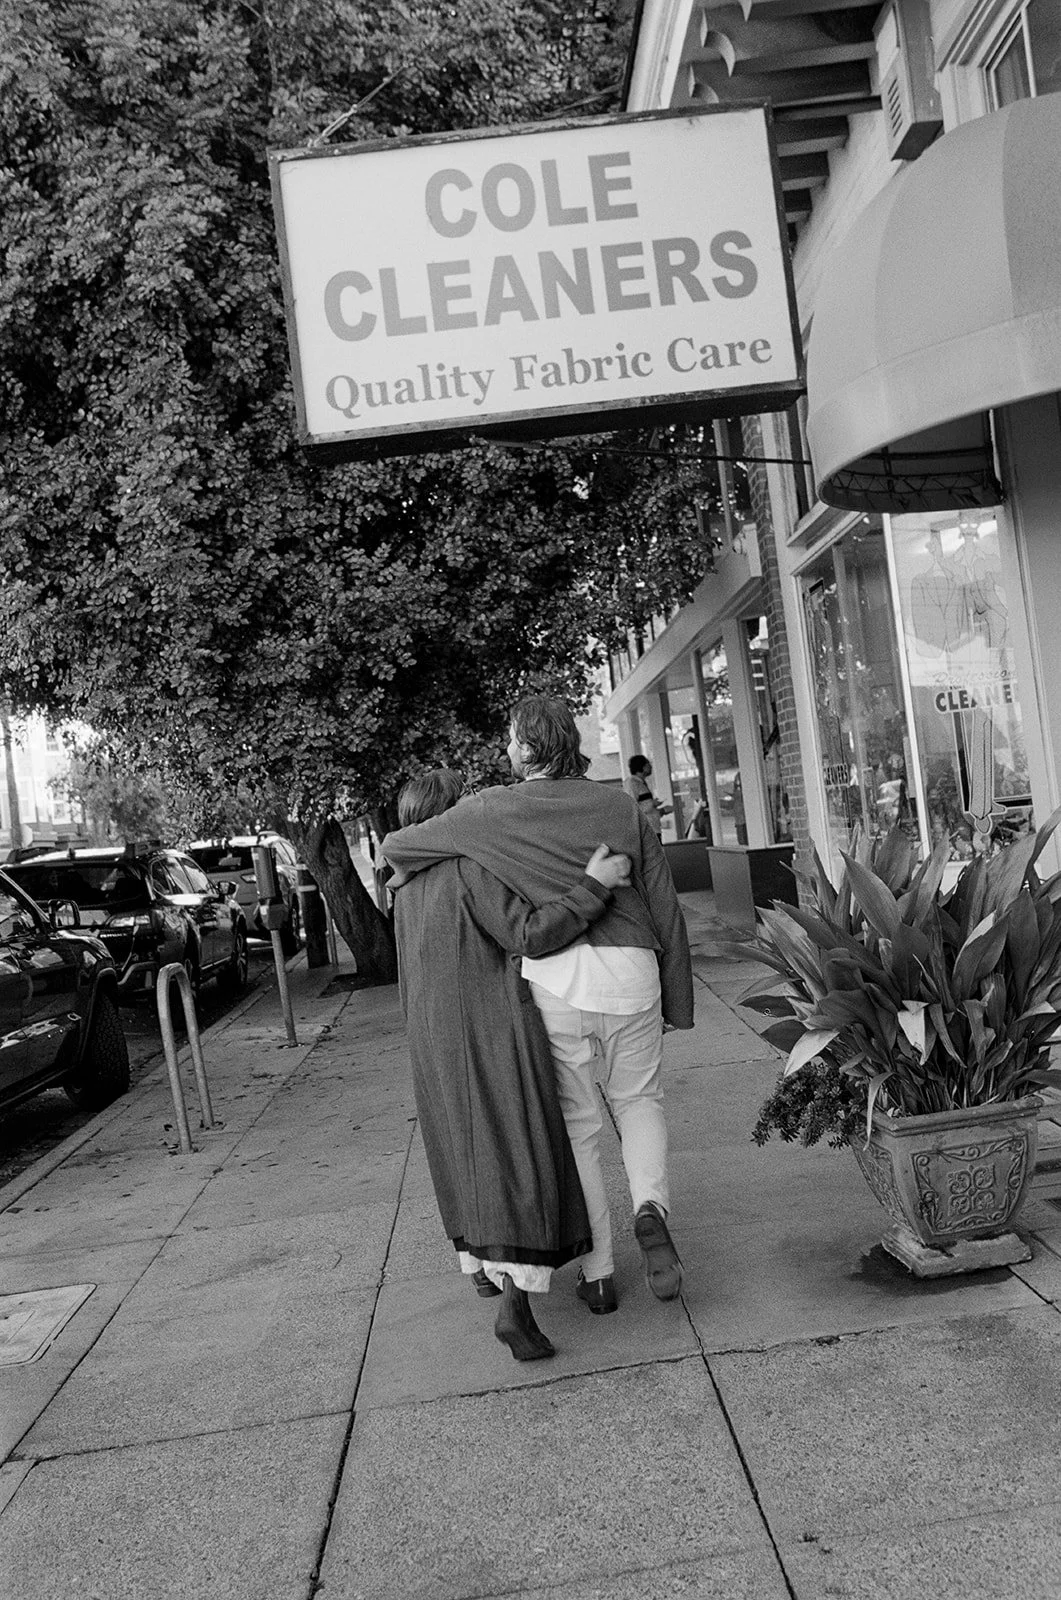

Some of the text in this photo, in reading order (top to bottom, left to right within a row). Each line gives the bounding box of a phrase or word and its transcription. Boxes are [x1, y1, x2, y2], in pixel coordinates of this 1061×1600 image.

[425, 151, 639, 238] COLE
[324, 229, 759, 341] CLEANERS
[326, 337, 773, 419] Quality Fabric Care
